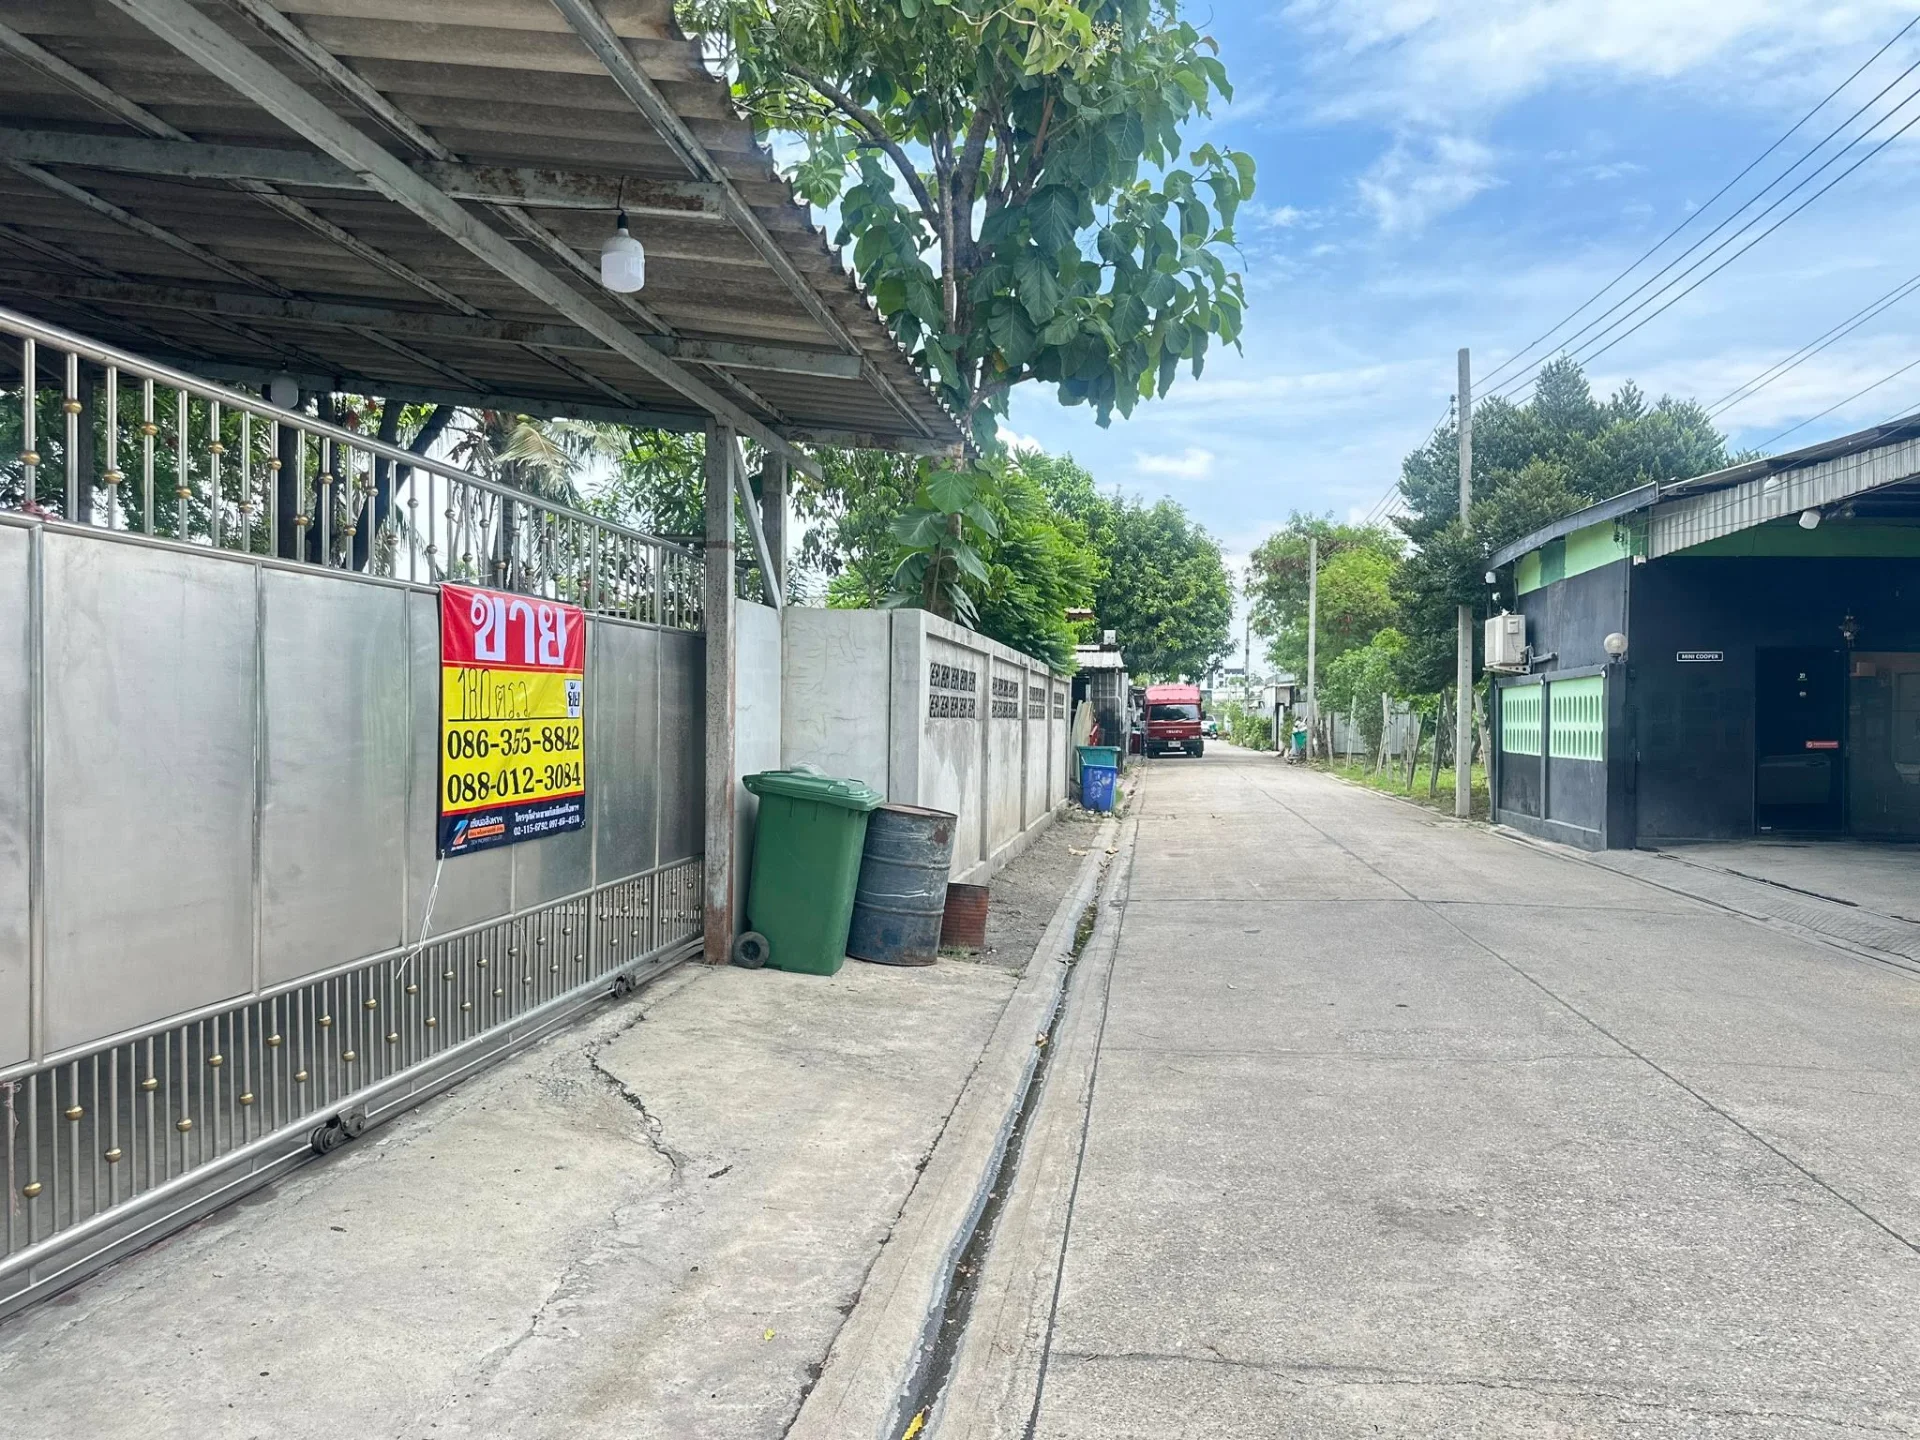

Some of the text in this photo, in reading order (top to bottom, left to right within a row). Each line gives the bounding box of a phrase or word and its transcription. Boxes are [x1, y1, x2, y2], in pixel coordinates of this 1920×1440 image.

[471, 593, 567, 665] ขาย
[458, 667, 491, 721] 180
[447, 726, 579, 759] 086-355-8842
[447, 762, 581, 804] 088-012-3084
